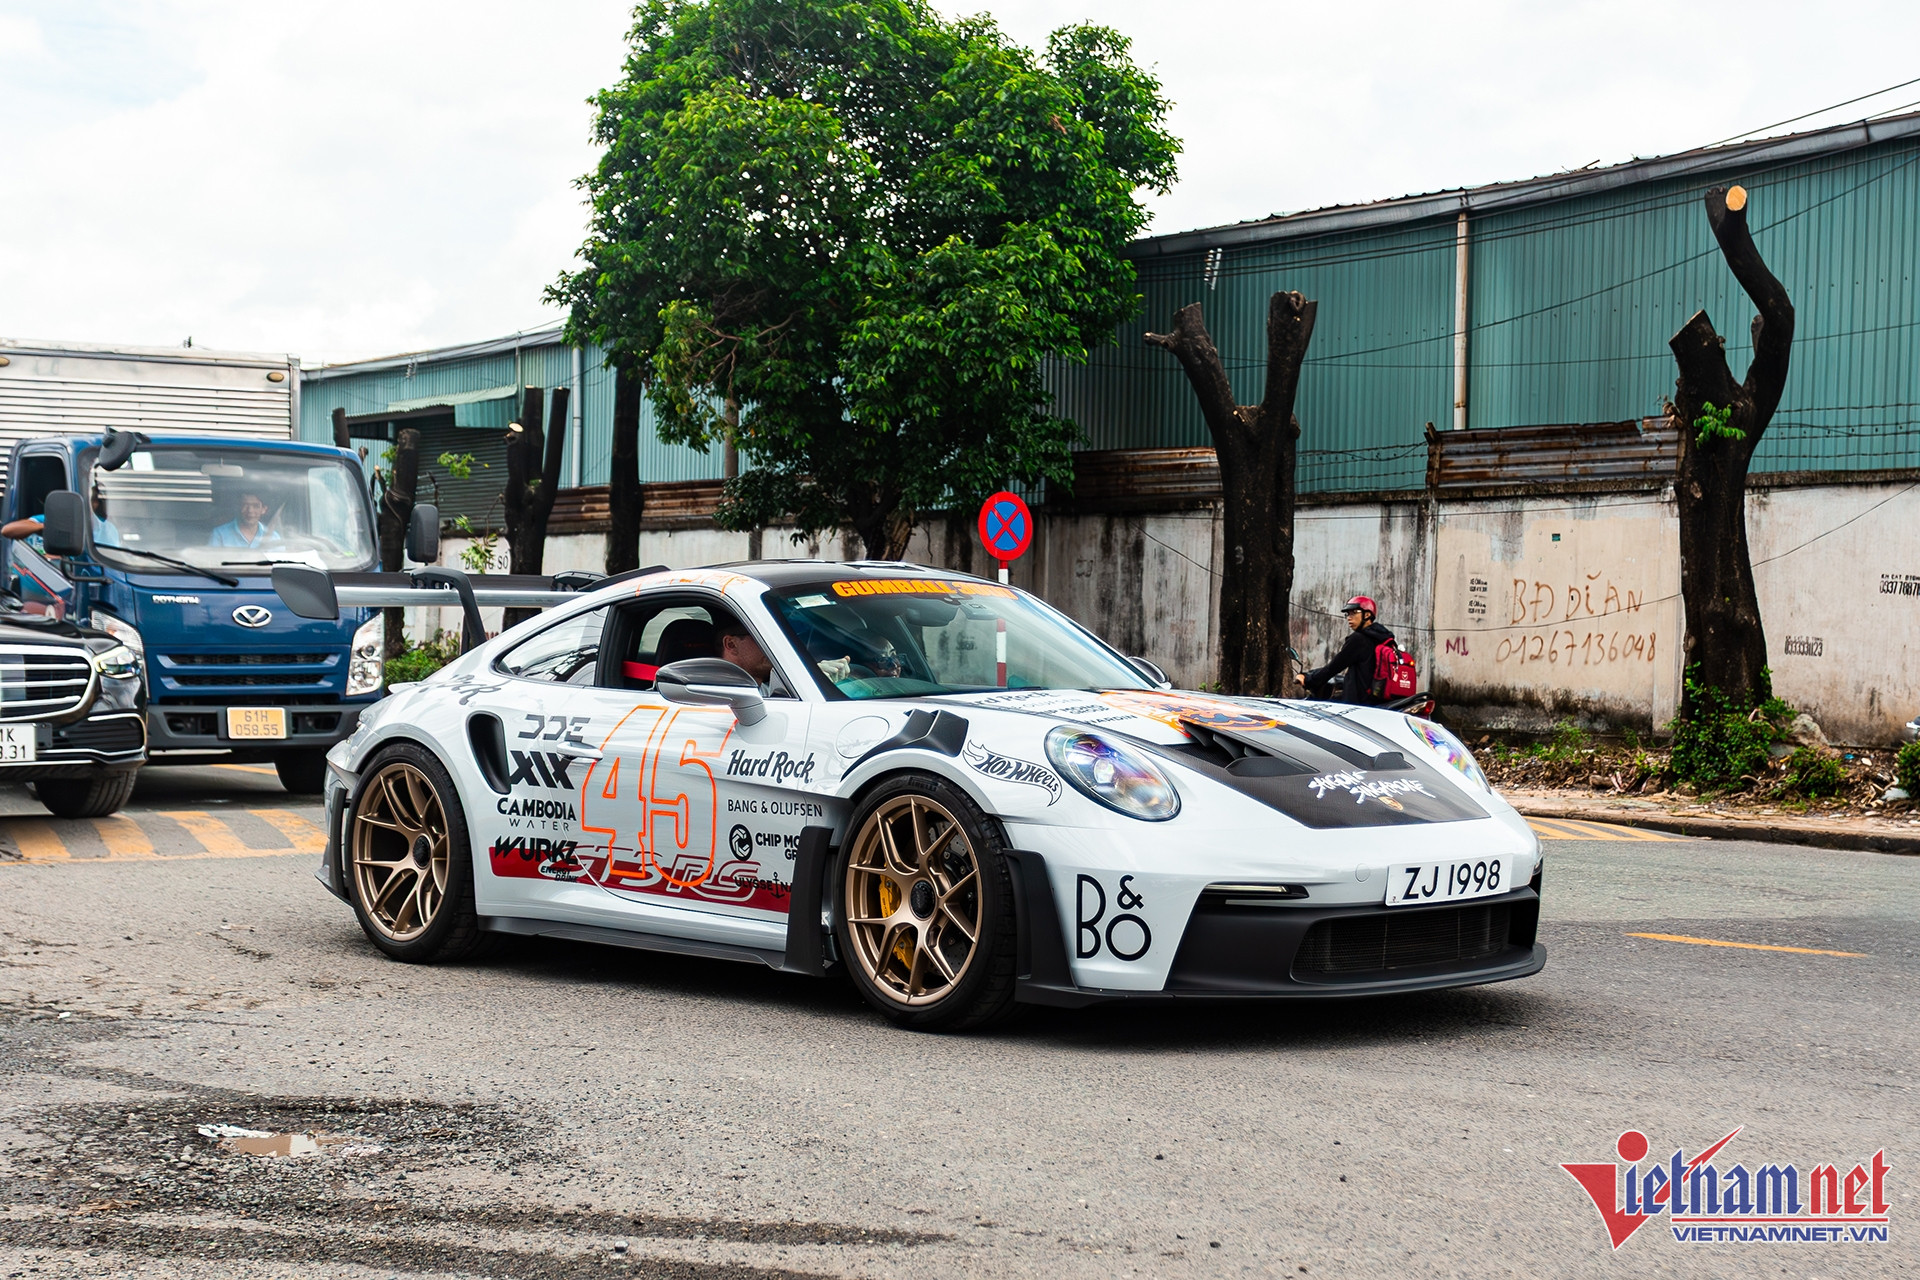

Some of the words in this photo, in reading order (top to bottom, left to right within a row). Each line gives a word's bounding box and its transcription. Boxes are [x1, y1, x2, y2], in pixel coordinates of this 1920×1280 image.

[832, 579, 957, 597] GUMBALL
[1604, 579, 1643, 616] AN
[1496, 629, 1656, 666] 01267136048
[244, 710, 268, 722] 61H
[235, 724, 279, 736] 058.55
[727, 749, 775, 777] Hard
[582, 705, 739, 888] 45
[497, 797, 577, 821] CAMBODIA
[728, 799, 757, 813] BANG
[761, 801, 768, 814] &
[770, 802, 823, 817] OLUFSEN
[509, 818, 569, 832] WATER
[755, 832, 782, 847] CHIP
[495, 835, 578, 865] WURKZ
[541, 865, 571, 875] ENERGY
[1402, 866, 1439, 899] ZJ
[1448, 859, 1501, 896] 1998
[734, 876, 773, 891] ULYSSE
